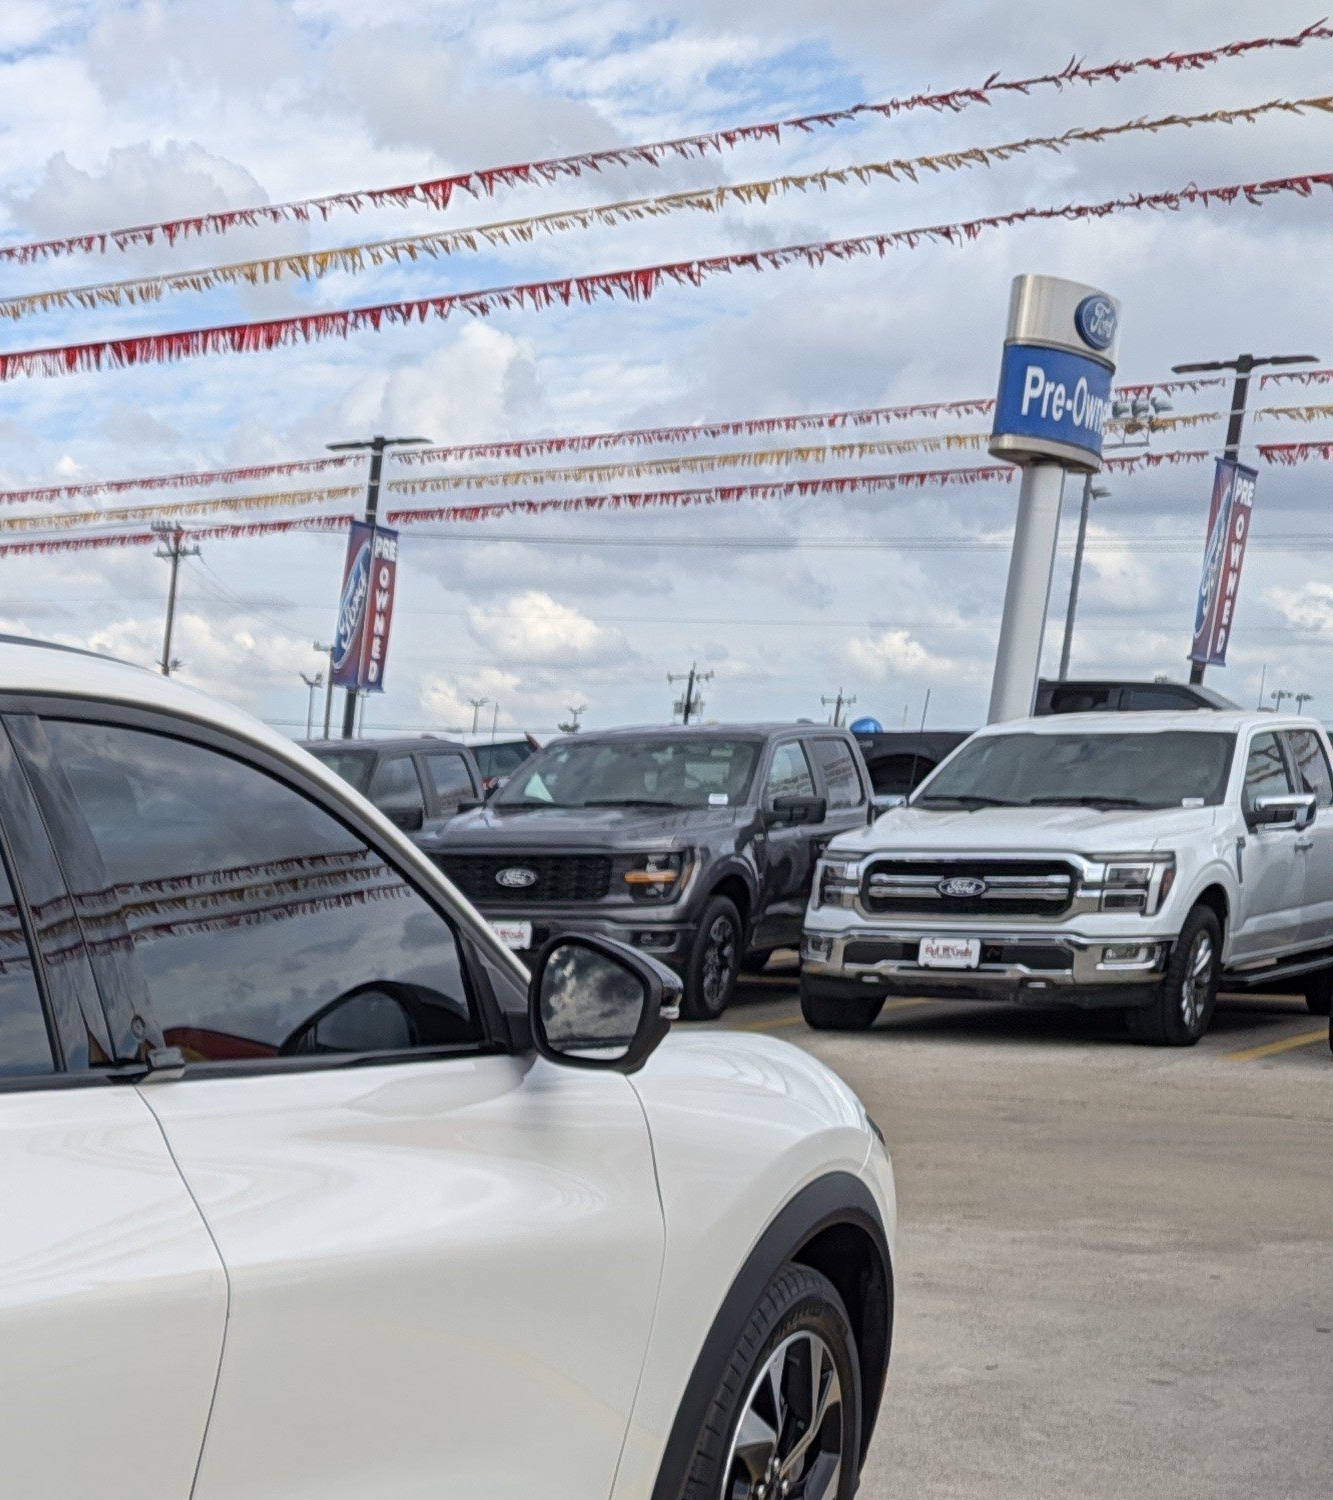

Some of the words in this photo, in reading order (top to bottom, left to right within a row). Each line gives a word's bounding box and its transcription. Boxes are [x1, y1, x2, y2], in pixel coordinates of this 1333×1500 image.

[1021, 365, 1105, 435] Pre-Own
[1234, 477, 1255, 508] PRE
[374, 535, 397, 562] PRE
[1216, 513, 1245, 654] OWNED
[367, 566, 390, 683] OWNED
[947, 879, 976, 894] Ford
